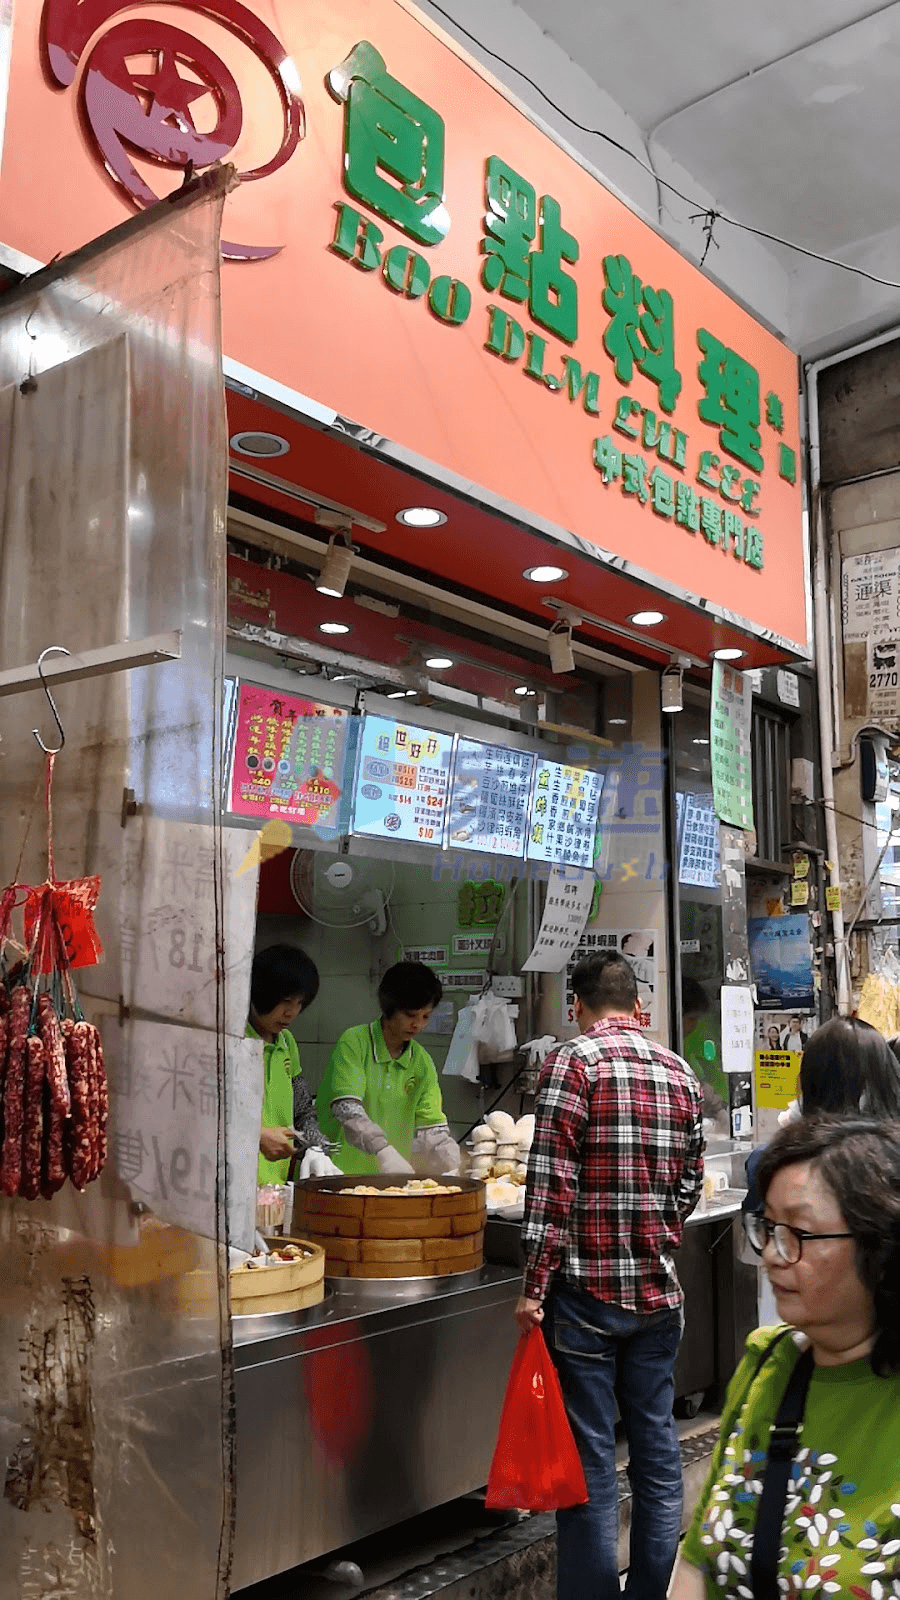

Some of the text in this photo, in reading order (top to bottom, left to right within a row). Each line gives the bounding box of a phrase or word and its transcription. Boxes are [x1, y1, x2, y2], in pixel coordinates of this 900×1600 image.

[325, 40, 764, 471] 包點料理
[593, 435, 763, 569] 中式包點專門店
[869, 671, 898, 688] 2770
[426, 794, 444, 808] $24
[418, 826, 434, 839] $10
